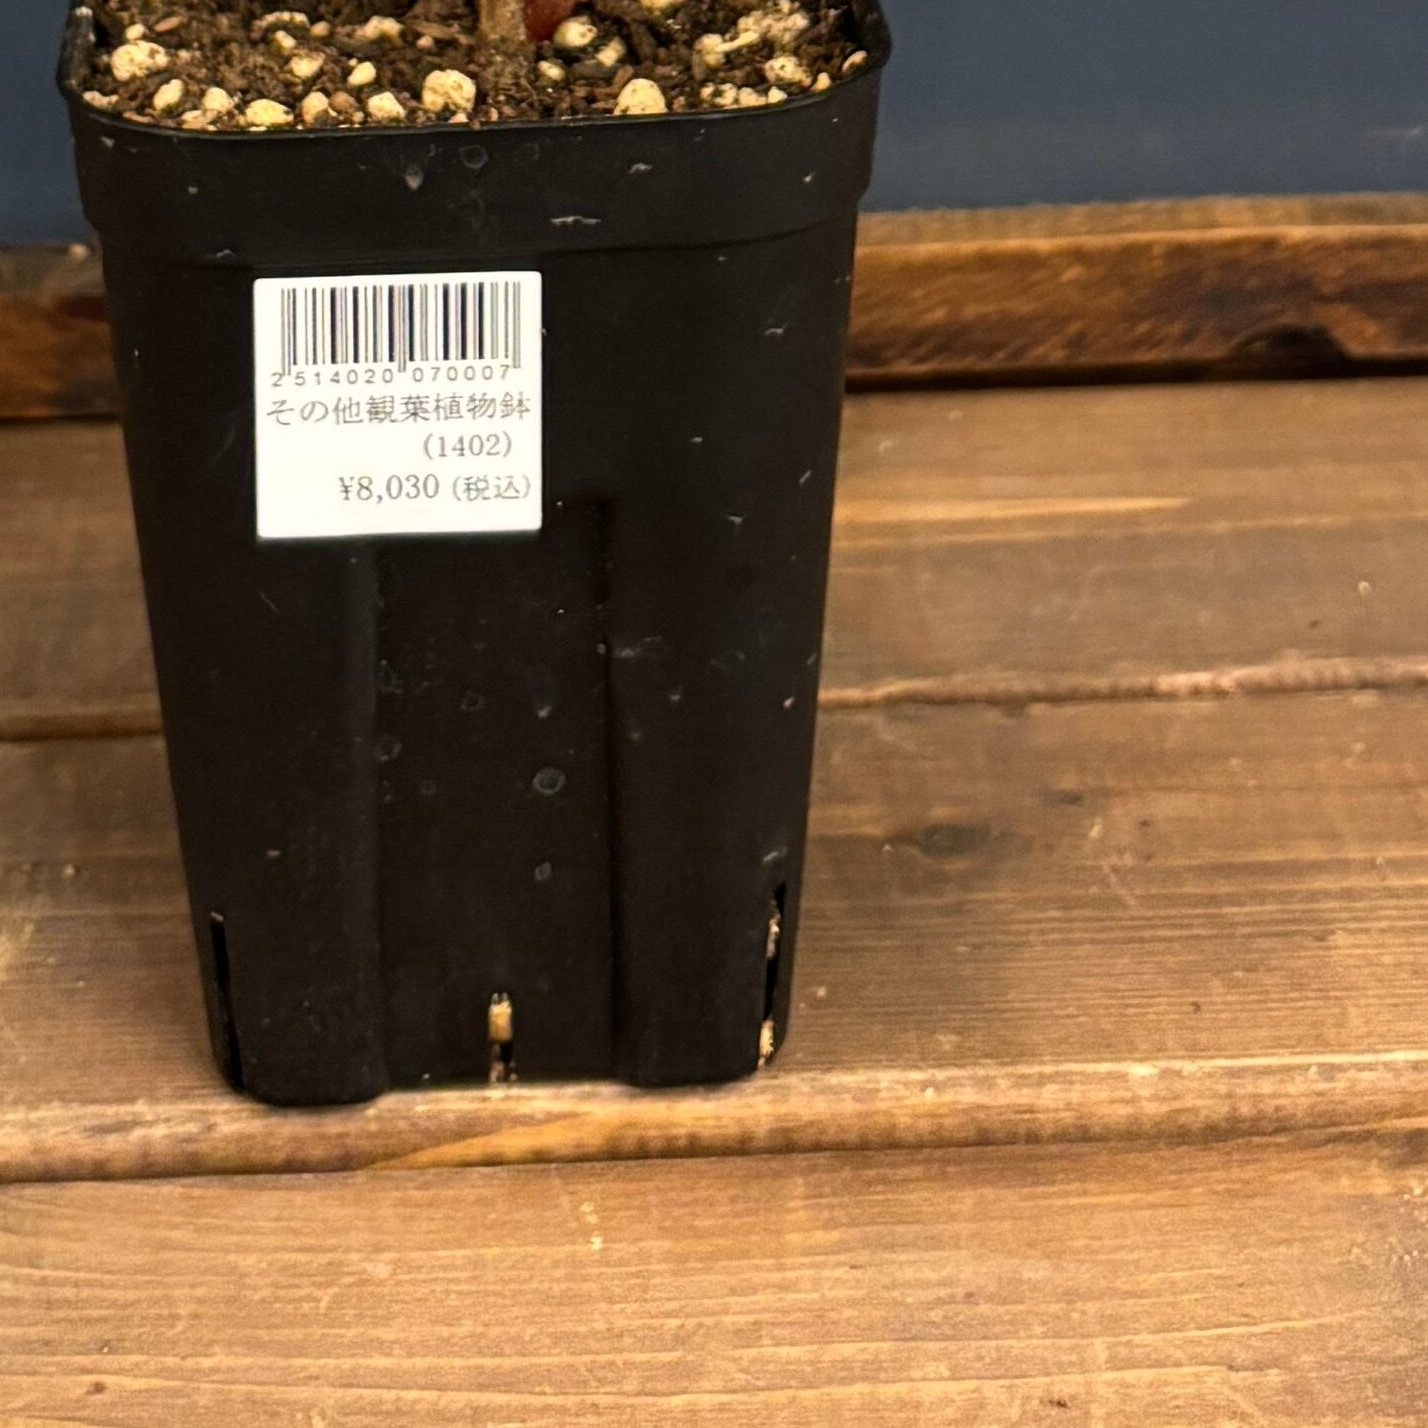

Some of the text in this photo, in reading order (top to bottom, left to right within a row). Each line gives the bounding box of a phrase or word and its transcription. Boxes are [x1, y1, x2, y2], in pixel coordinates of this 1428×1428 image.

[266, 391, 532, 425] その他観葉植物鉢
[423, 431, 512, 460] (1402)
[338, 473, 440, 504] ¥8,030
